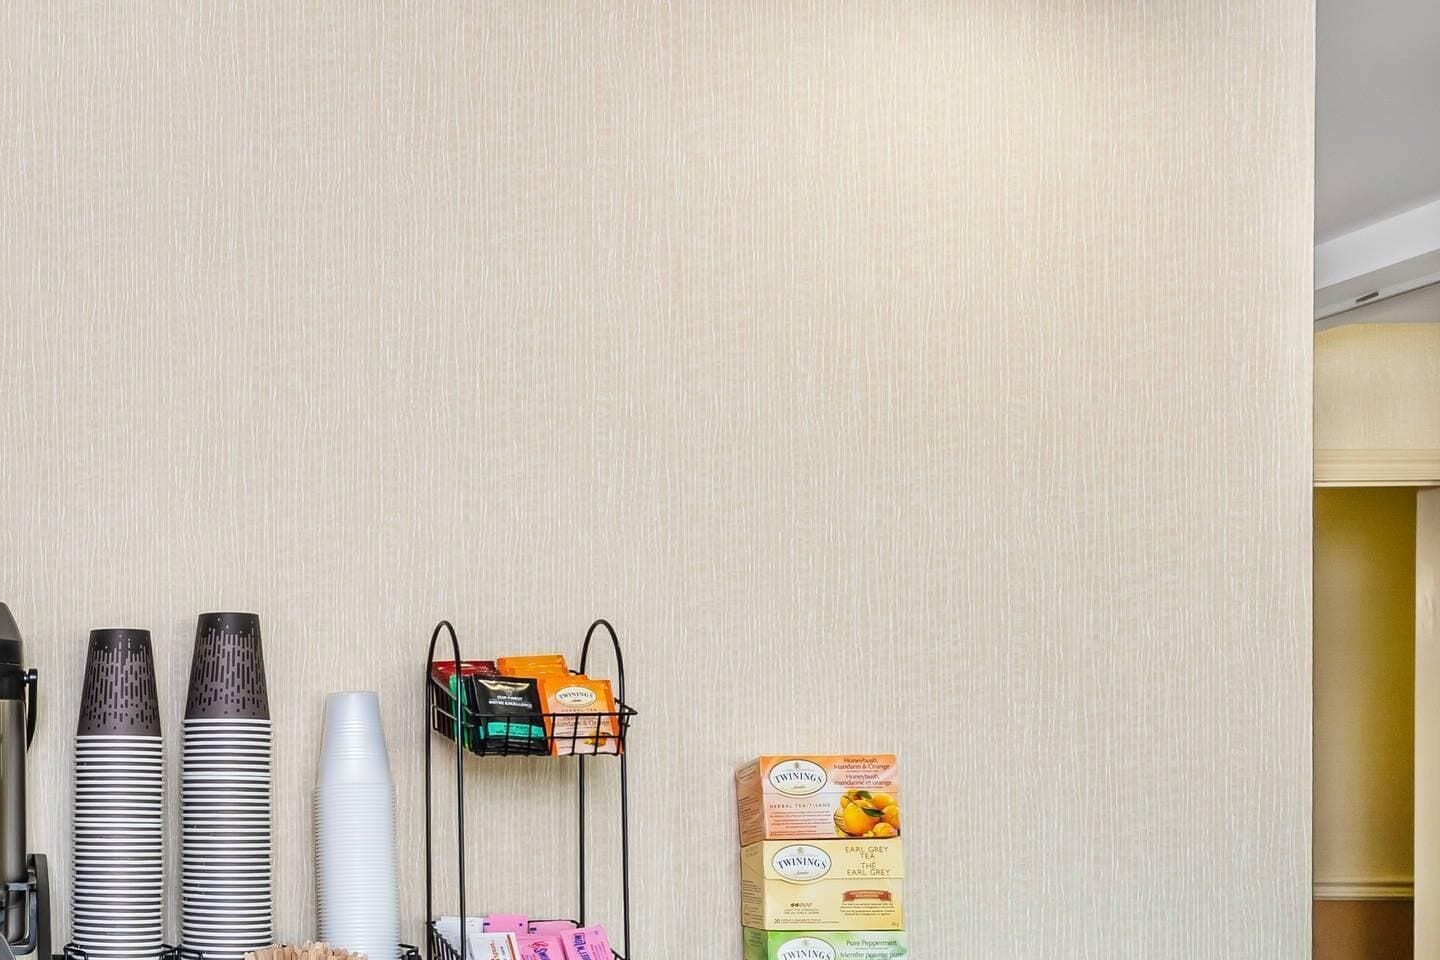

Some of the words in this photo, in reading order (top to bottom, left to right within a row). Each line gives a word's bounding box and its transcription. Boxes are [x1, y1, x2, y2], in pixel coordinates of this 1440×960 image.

[559, 691, 593, 699] TWININGS
[774, 771, 822, 784] TWININGS
[777, 858, 827, 869] TWININGS
[782, 949, 831, 960] TWININGS
